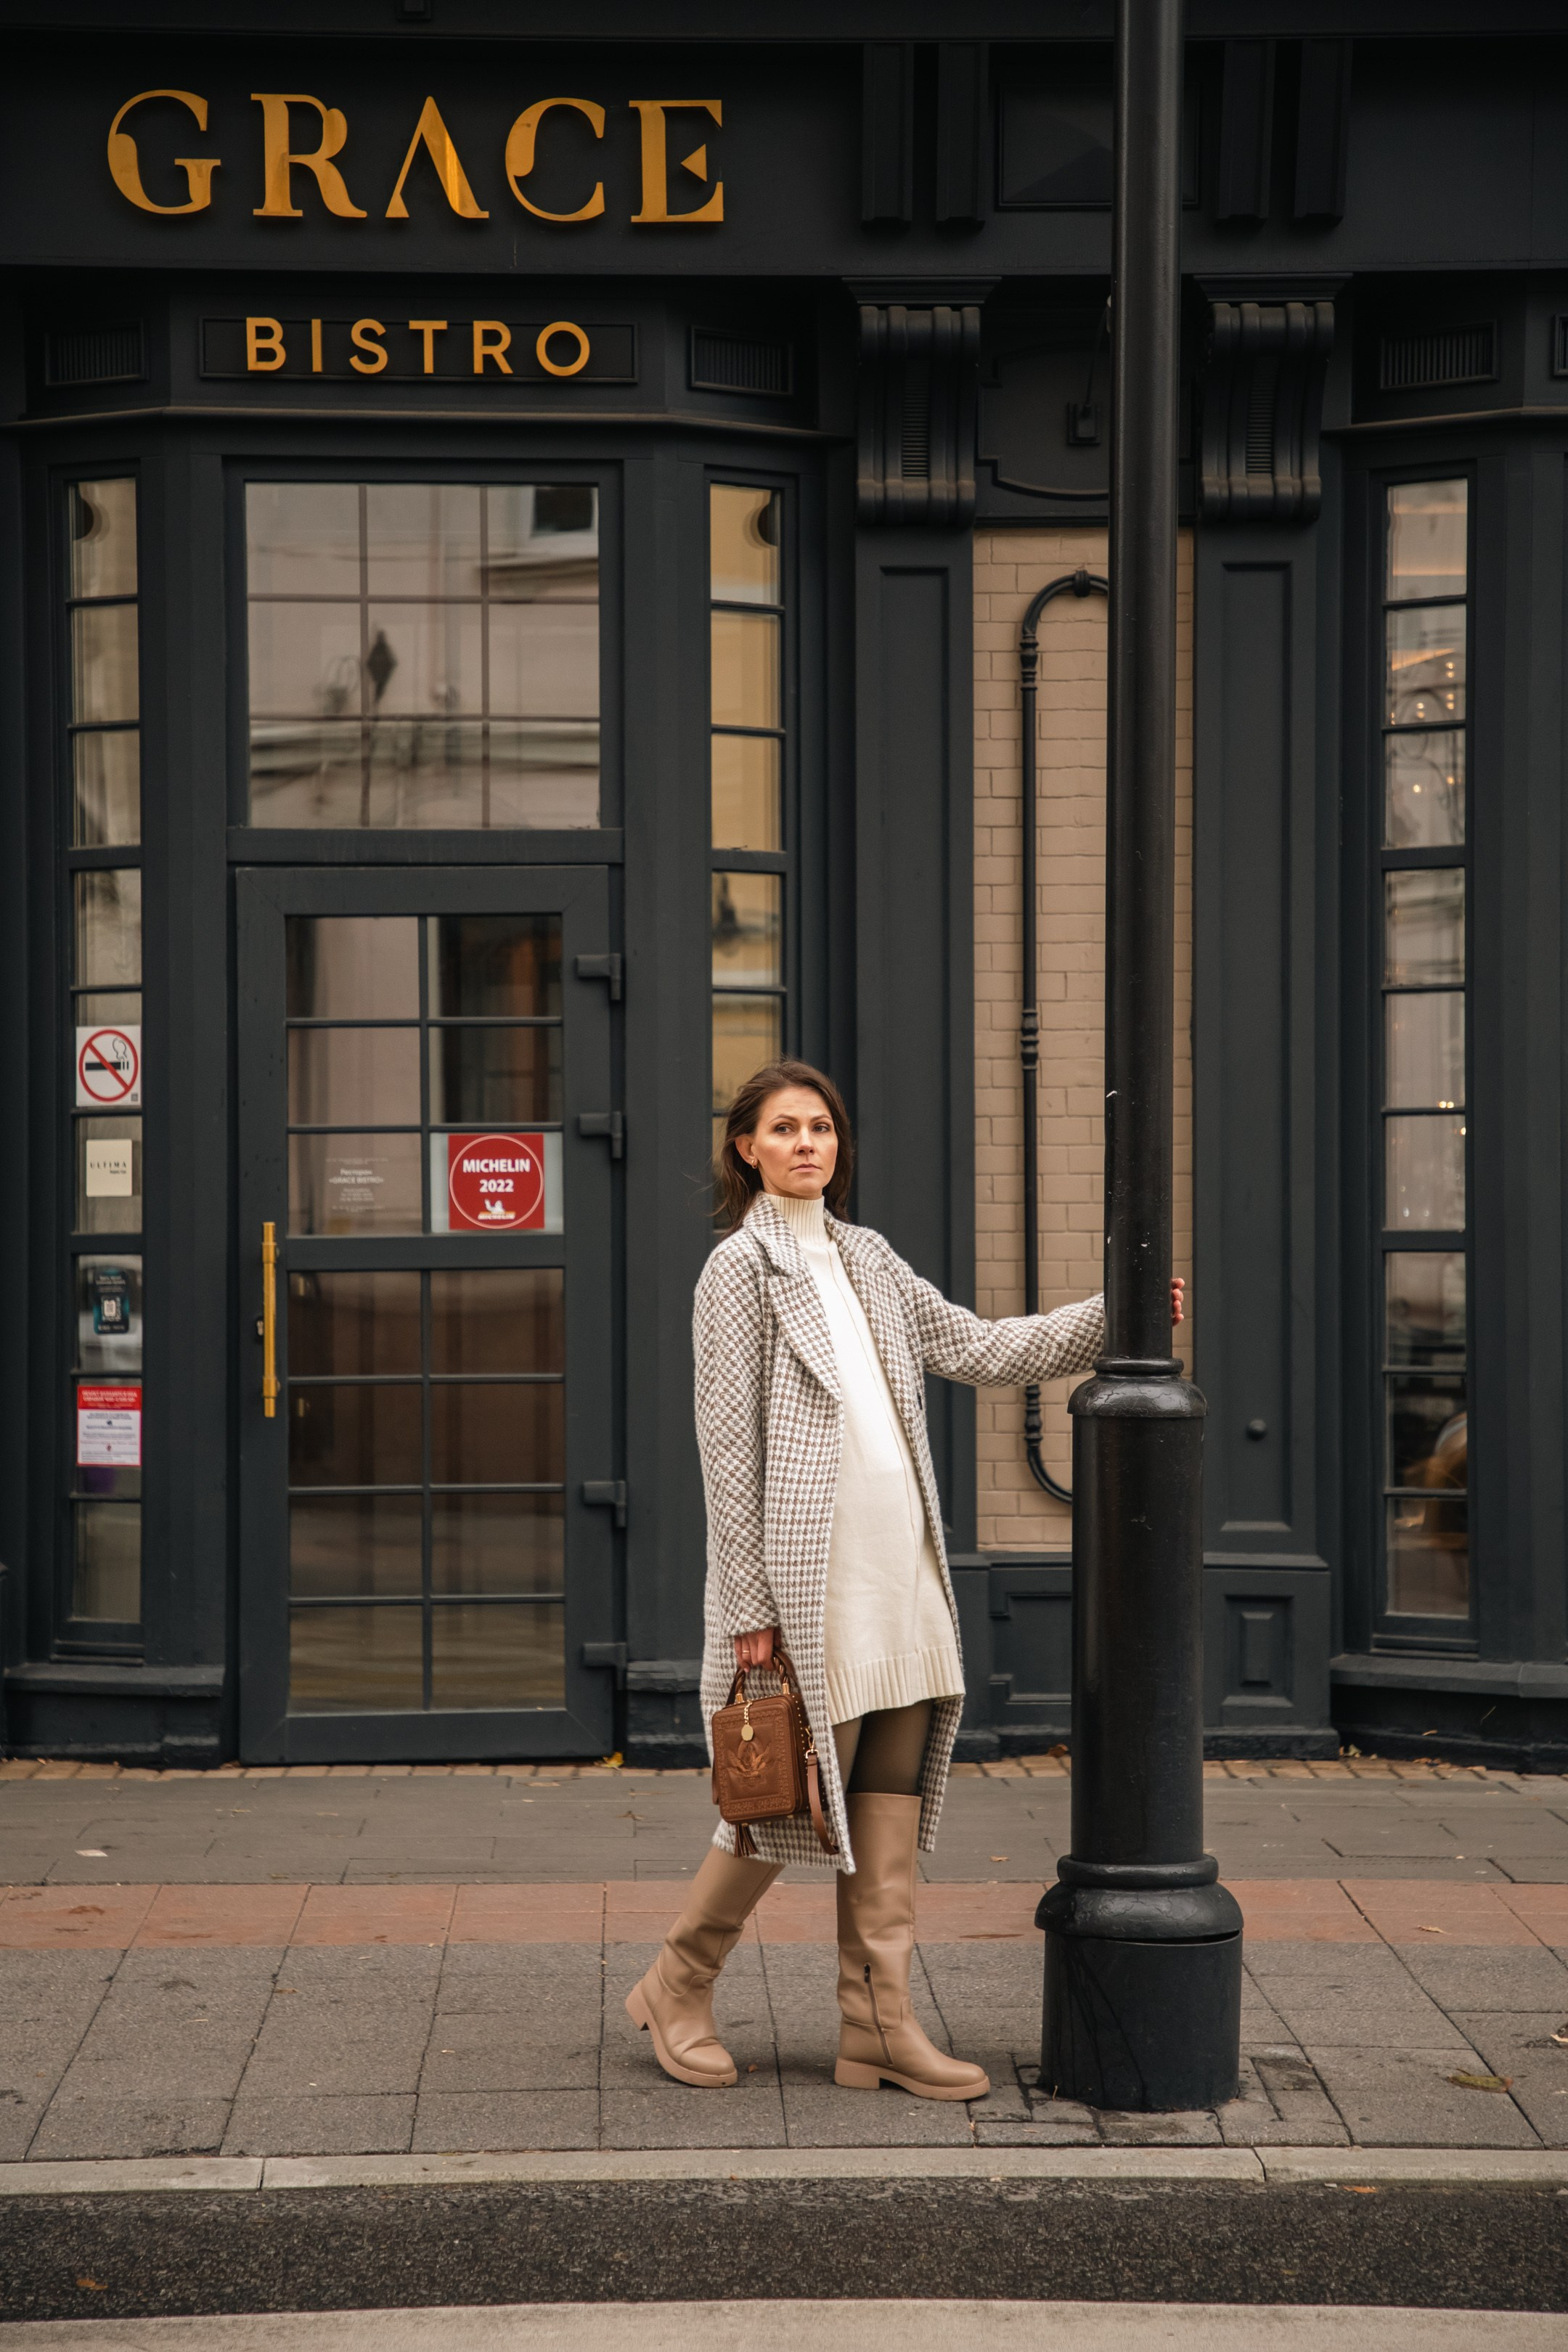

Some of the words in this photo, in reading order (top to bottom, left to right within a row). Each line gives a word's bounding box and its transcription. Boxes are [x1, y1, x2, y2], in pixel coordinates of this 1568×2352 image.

[107, 89, 724, 223] GRACE
[246, 317, 590, 376] BISTRO
[462, 1158, 531, 1173] MICHELIN
[479, 1178, 514, 1193] 2022
